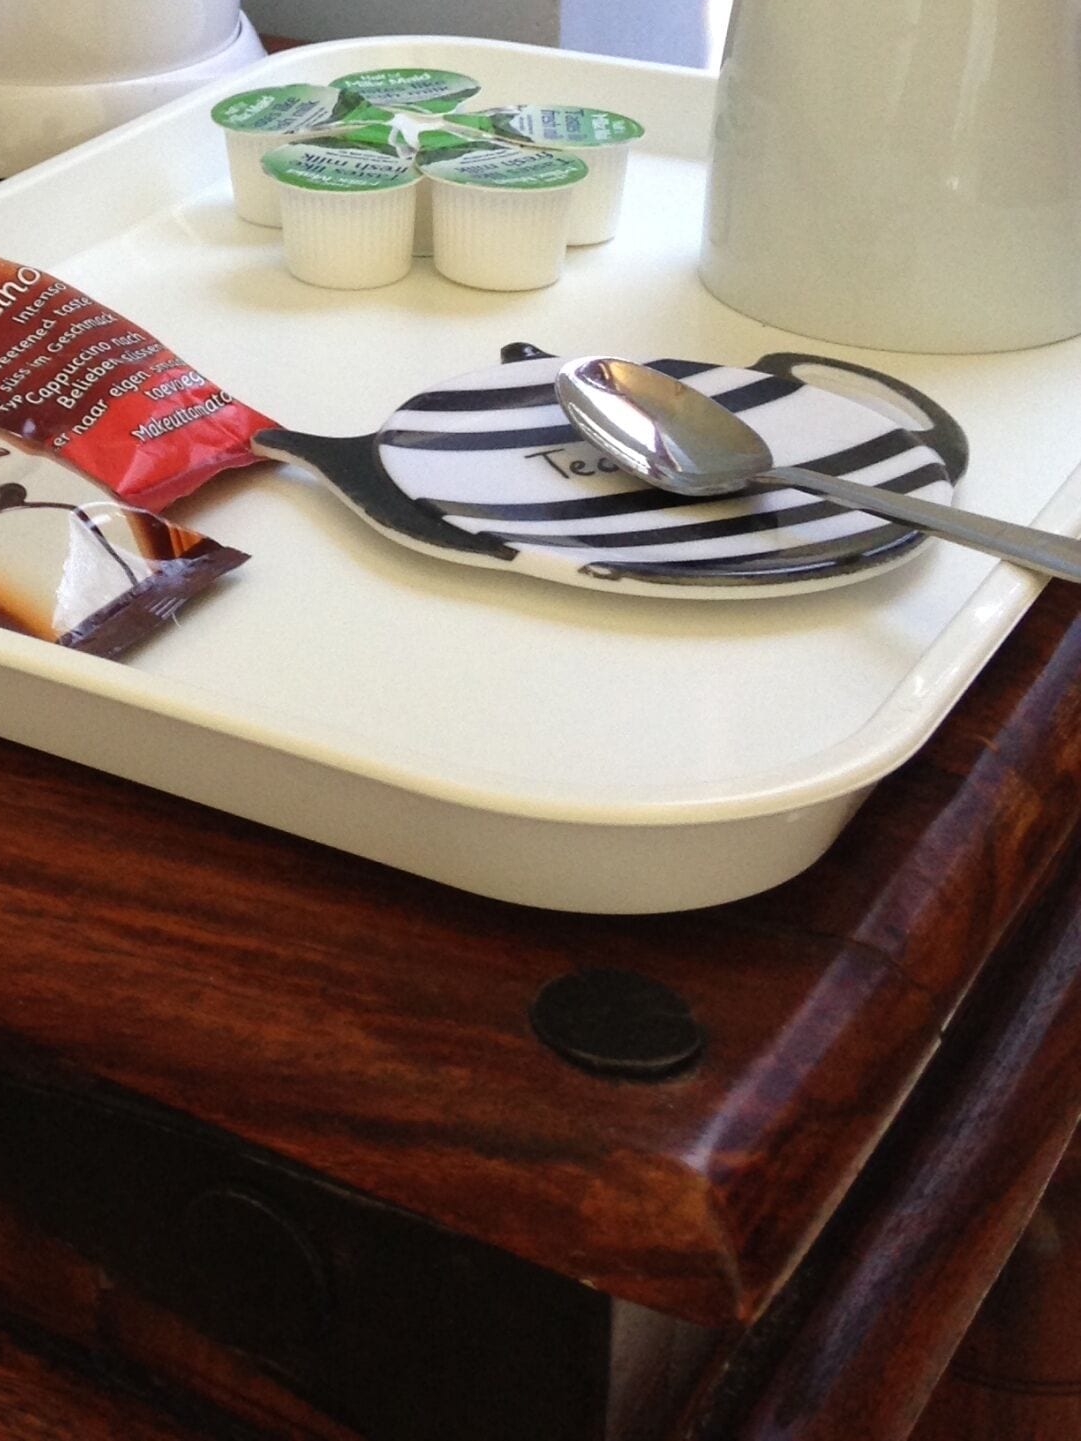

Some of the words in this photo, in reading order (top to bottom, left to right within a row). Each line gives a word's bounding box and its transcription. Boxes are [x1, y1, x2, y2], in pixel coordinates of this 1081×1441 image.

[301, 153, 349, 167] milk
[12, 281, 67, 324] Intenso
[53, 295, 93, 317] taste
[0, 367, 32, 392] süss
[30, 355, 52, 368] im
[47, 311, 118, 353] Geschmack
[24, 340, 112, 405] Cappuccino
[111, 330, 147, 348] nach
[53, 432, 70, 450] er
[72, 398, 109, 435] naar
[109, 369, 152, 398] eigen
[56, 357, 124, 410] Belieben
